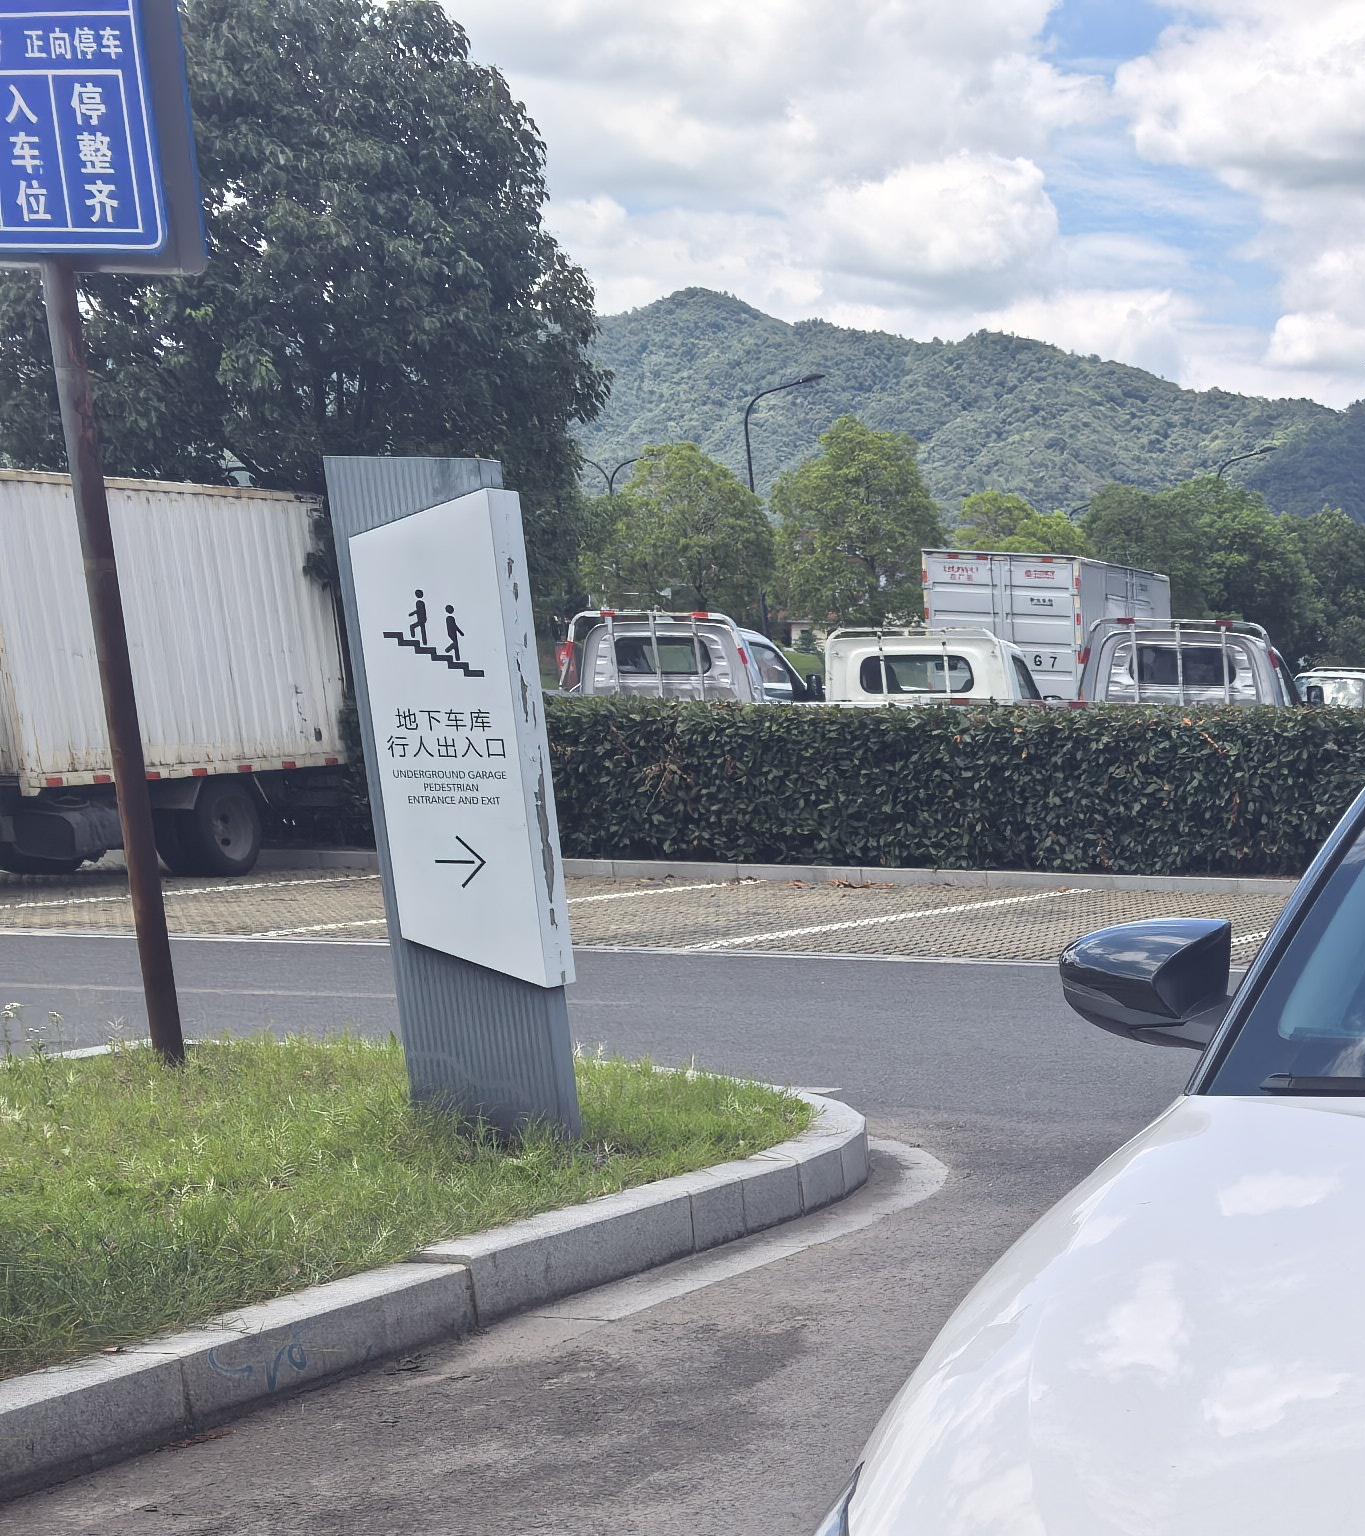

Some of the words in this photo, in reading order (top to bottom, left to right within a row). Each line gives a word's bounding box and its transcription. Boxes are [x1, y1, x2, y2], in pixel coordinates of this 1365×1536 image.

[23, 26, 123, 60] 正向停车
[395, 708, 492, 732] 地下车库
[386, 735, 506, 758] 行人出入口
[392, 769, 466, 779] UNDERGROUND
[467, 770, 508, 780] GARAGE
[423, 782, 479, 792] PEDESTRIAN
[407, 795, 456, 805] ENTRANCE
[458, 796, 479, 805] AND
[481, 796, 501, 805] EXIT
